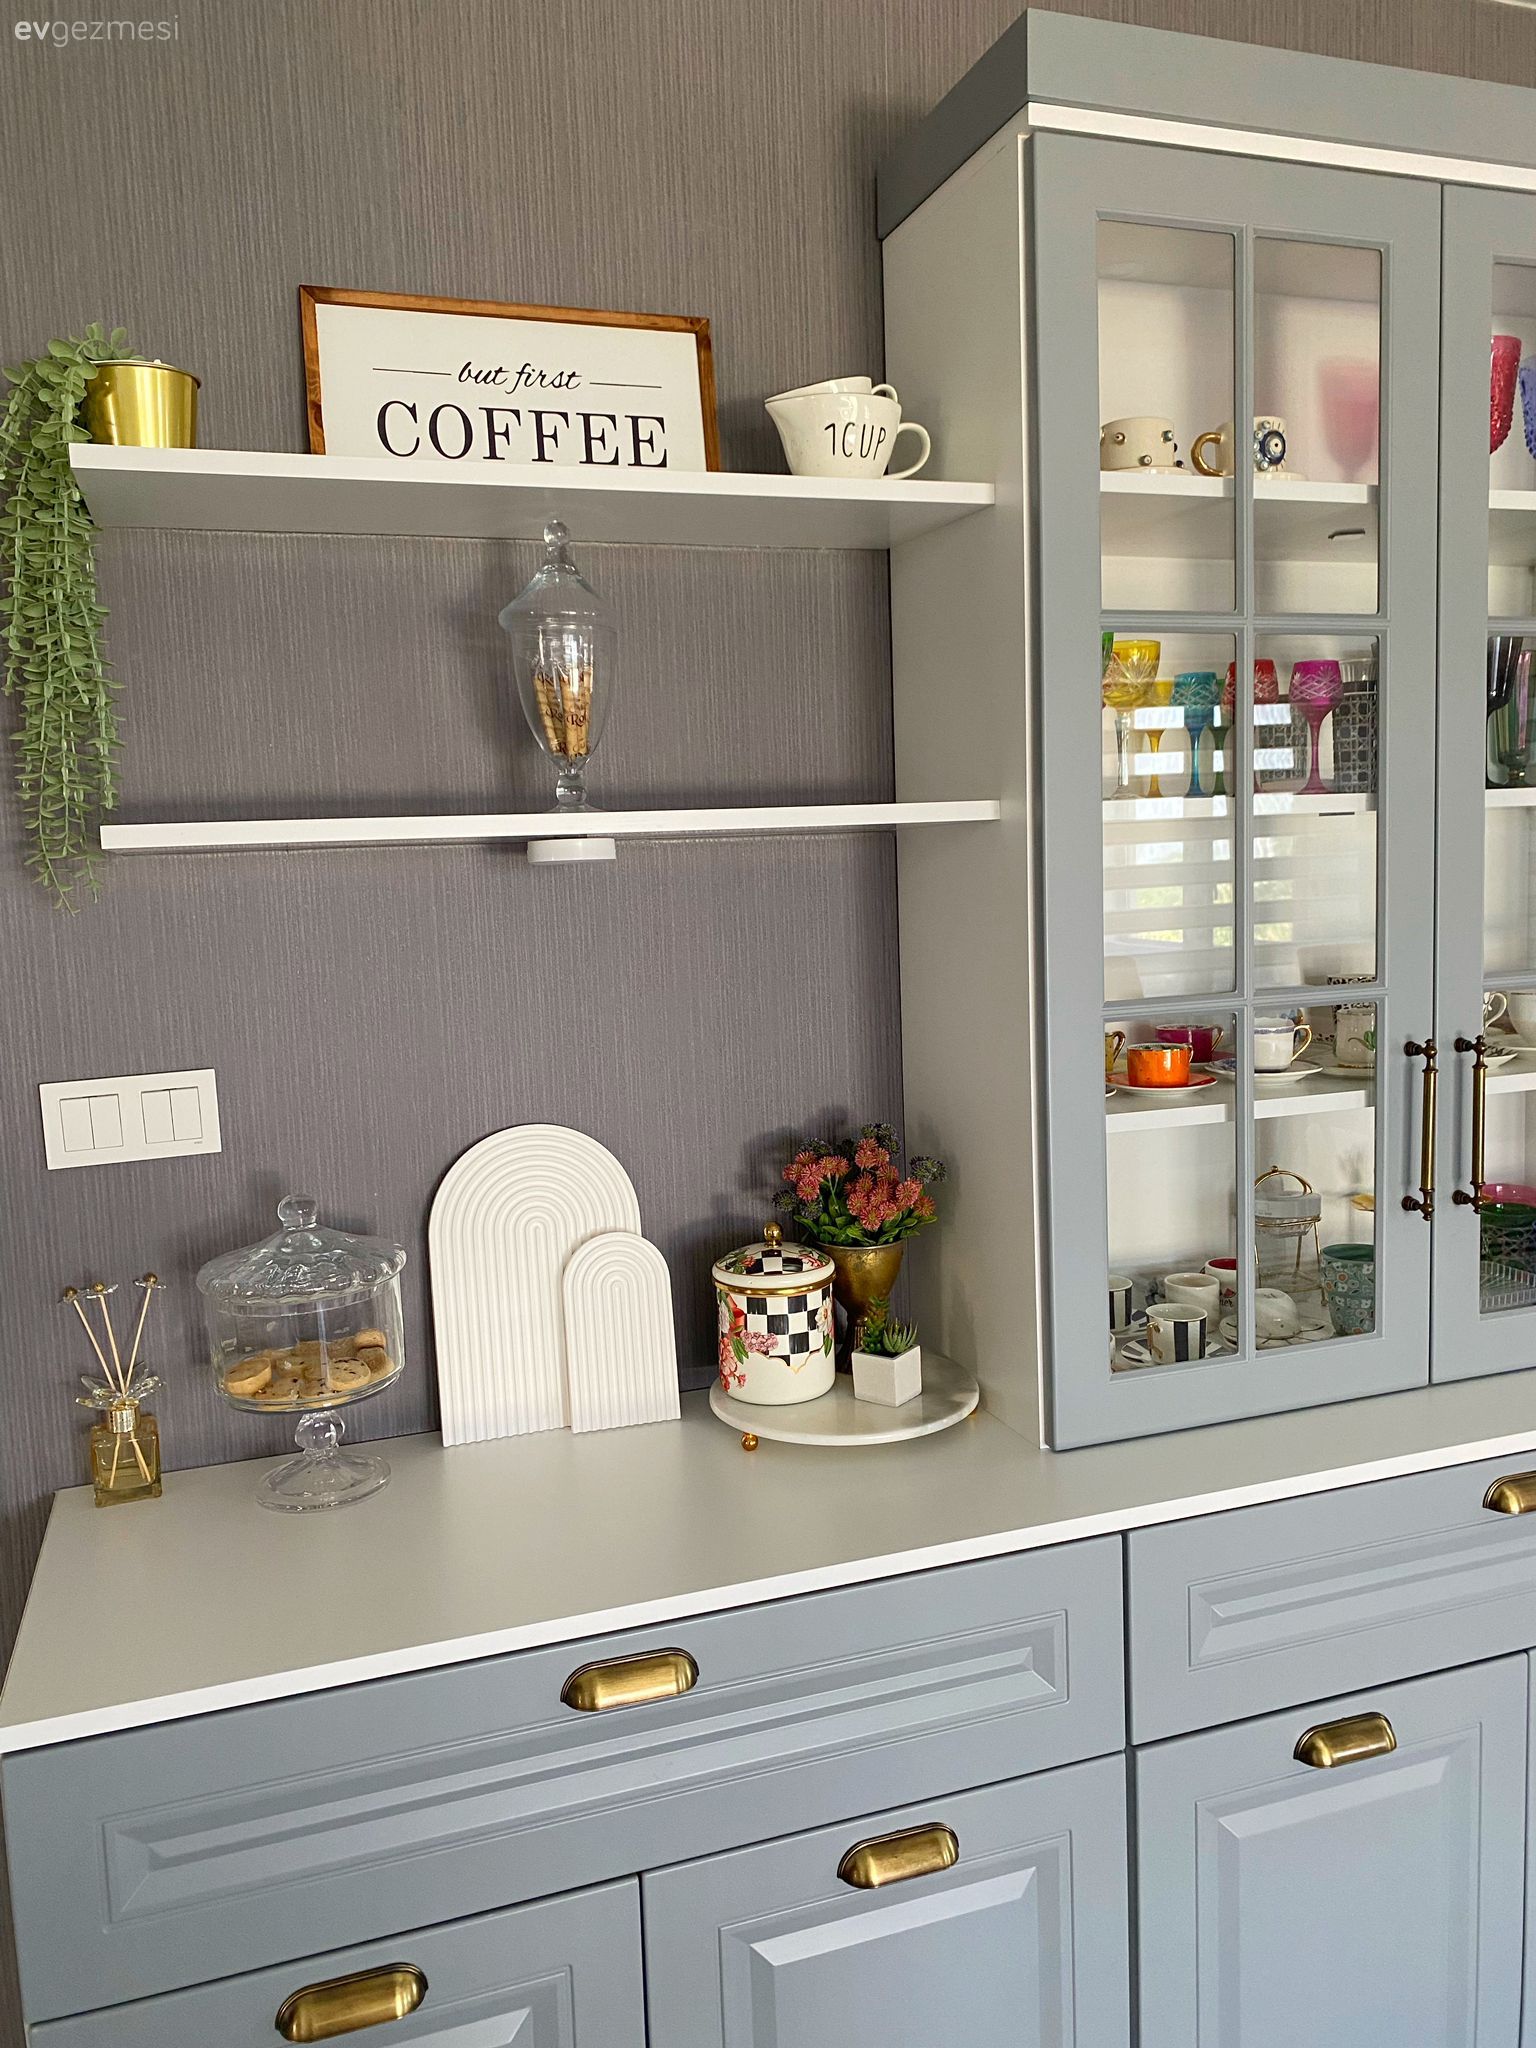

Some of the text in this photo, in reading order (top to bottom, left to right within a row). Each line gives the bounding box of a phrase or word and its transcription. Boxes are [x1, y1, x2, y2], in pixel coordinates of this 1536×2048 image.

[458, 361, 583, 395] but first
[377, 400, 668, 468] COFFEE
